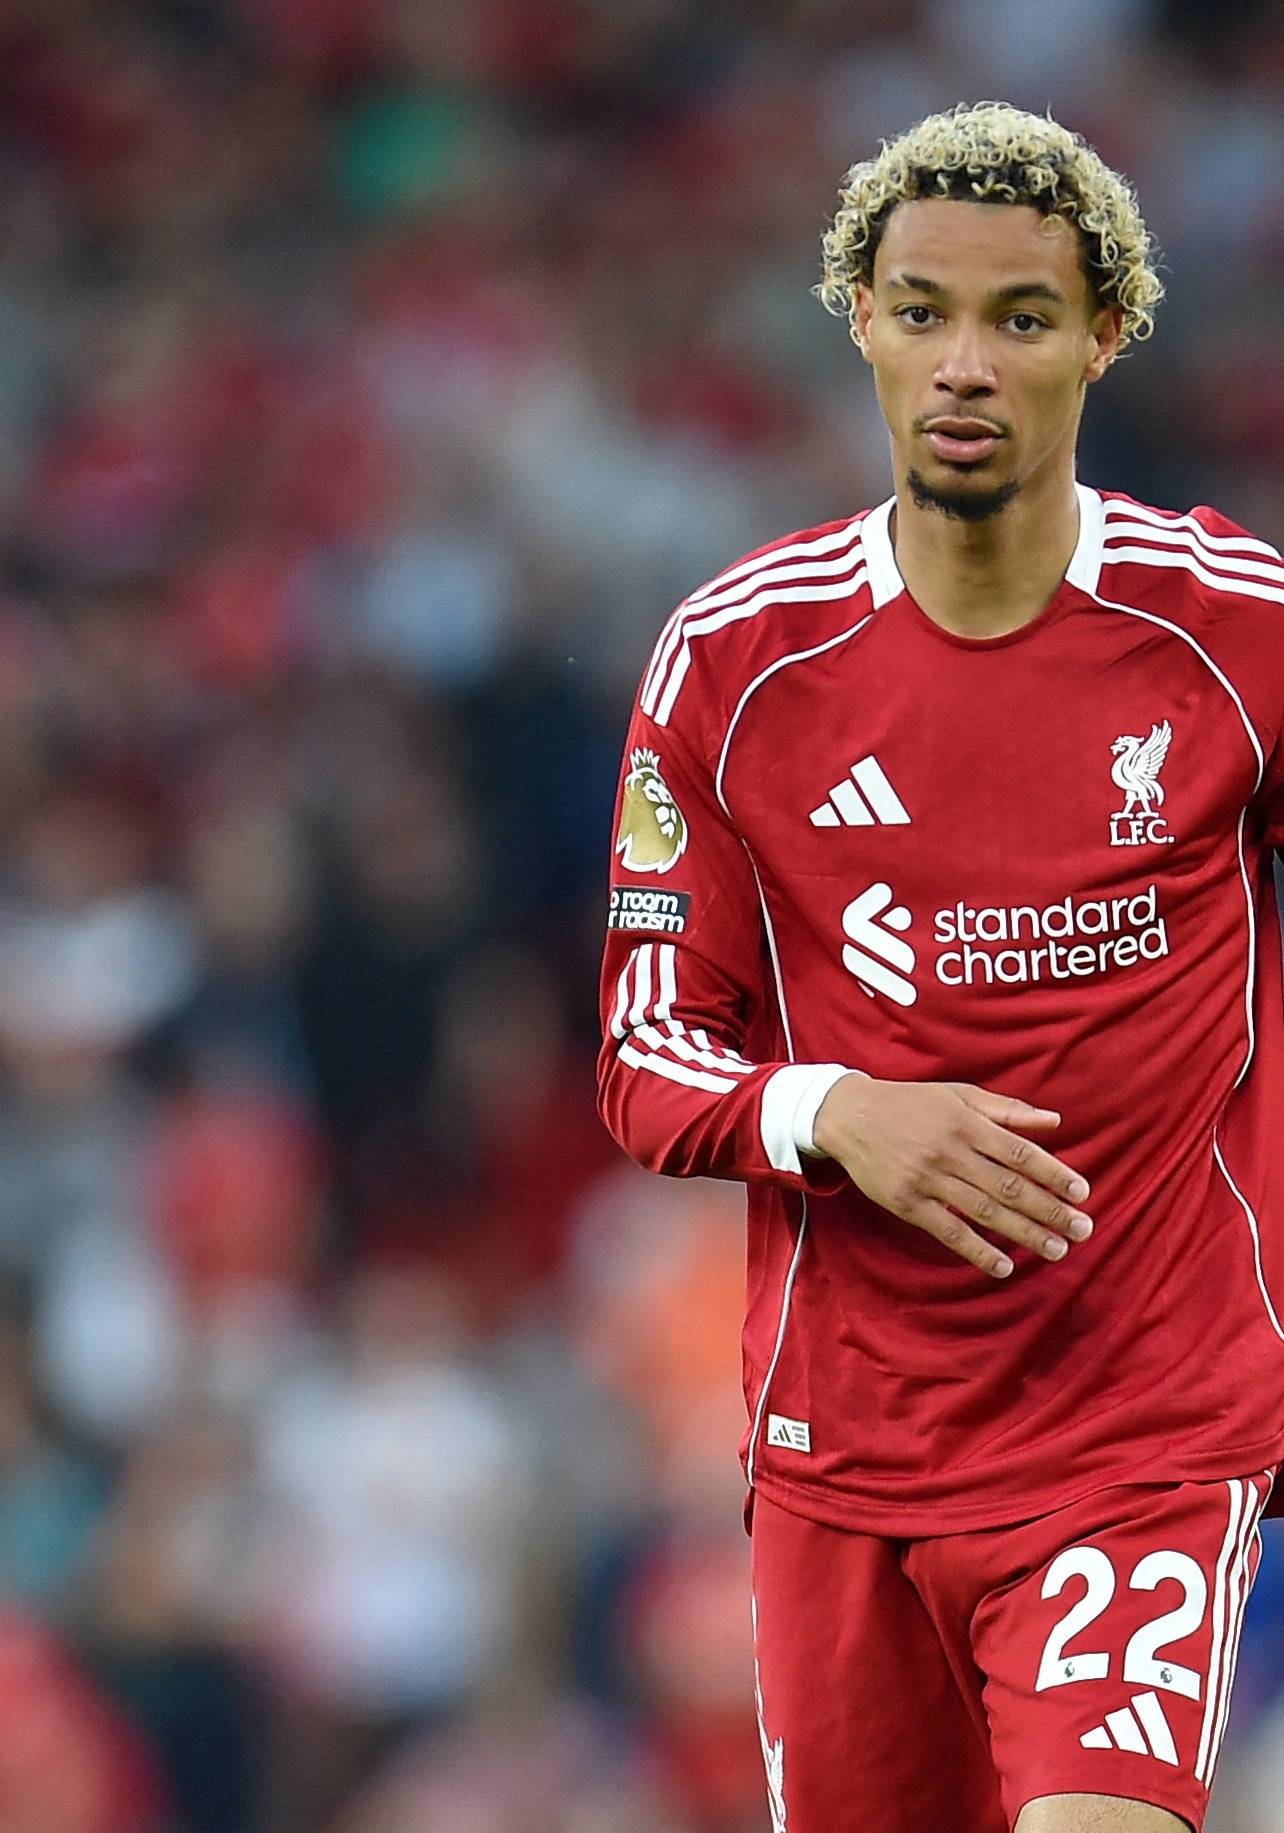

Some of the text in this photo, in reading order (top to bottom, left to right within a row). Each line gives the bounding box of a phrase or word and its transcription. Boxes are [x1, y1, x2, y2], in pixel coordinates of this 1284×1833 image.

[1109, 819, 1175, 846] L.F.C.
[619, 911, 684, 933] racism
[623, 891, 678, 913] room
[934, 884, 1157, 943] standard
[935, 918, 1169, 985] chartered
[1035, 1546, 1208, 1702] 22
